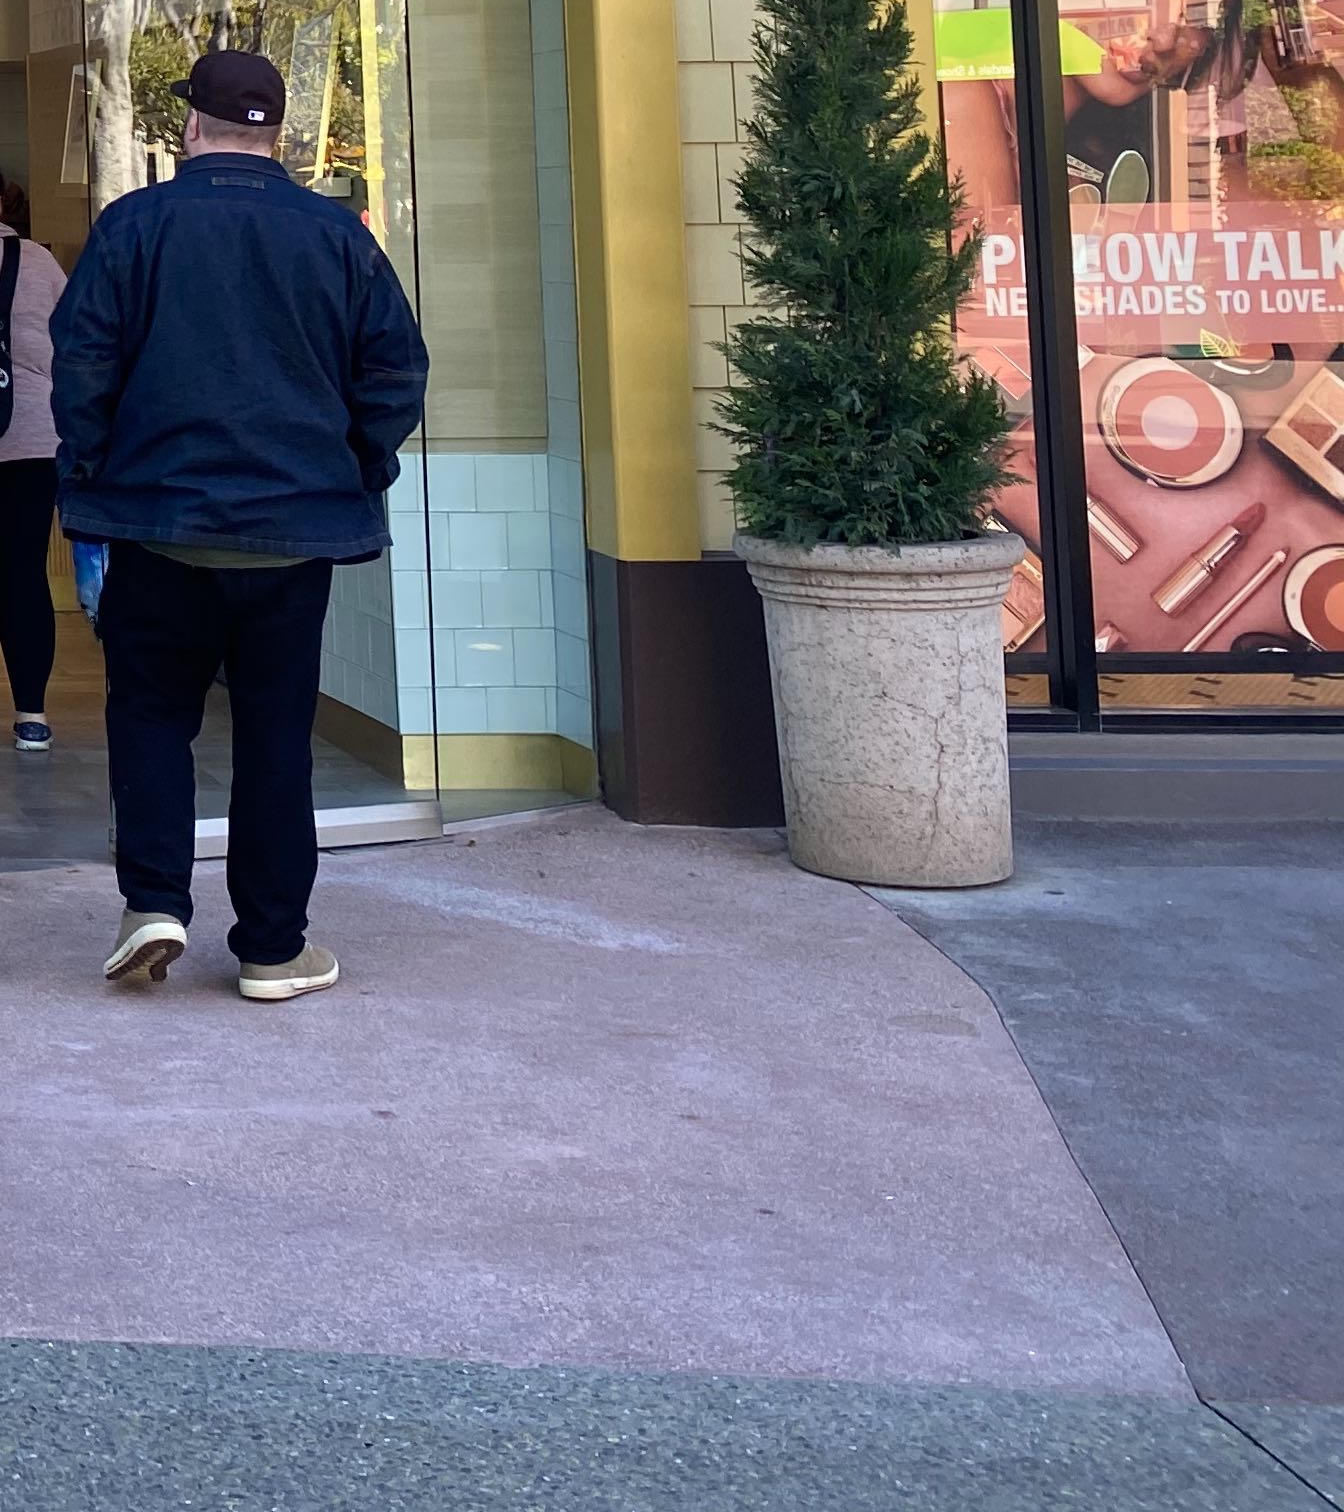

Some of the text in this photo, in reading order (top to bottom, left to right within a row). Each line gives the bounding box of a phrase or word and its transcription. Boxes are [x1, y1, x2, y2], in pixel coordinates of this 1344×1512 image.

[982, 232, 1198, 285] PLOW
[986, 285, 1029, 317] NE
[1075, 284, 1207, 316] SHADES
[1216, 290, 1251, 314] TO
